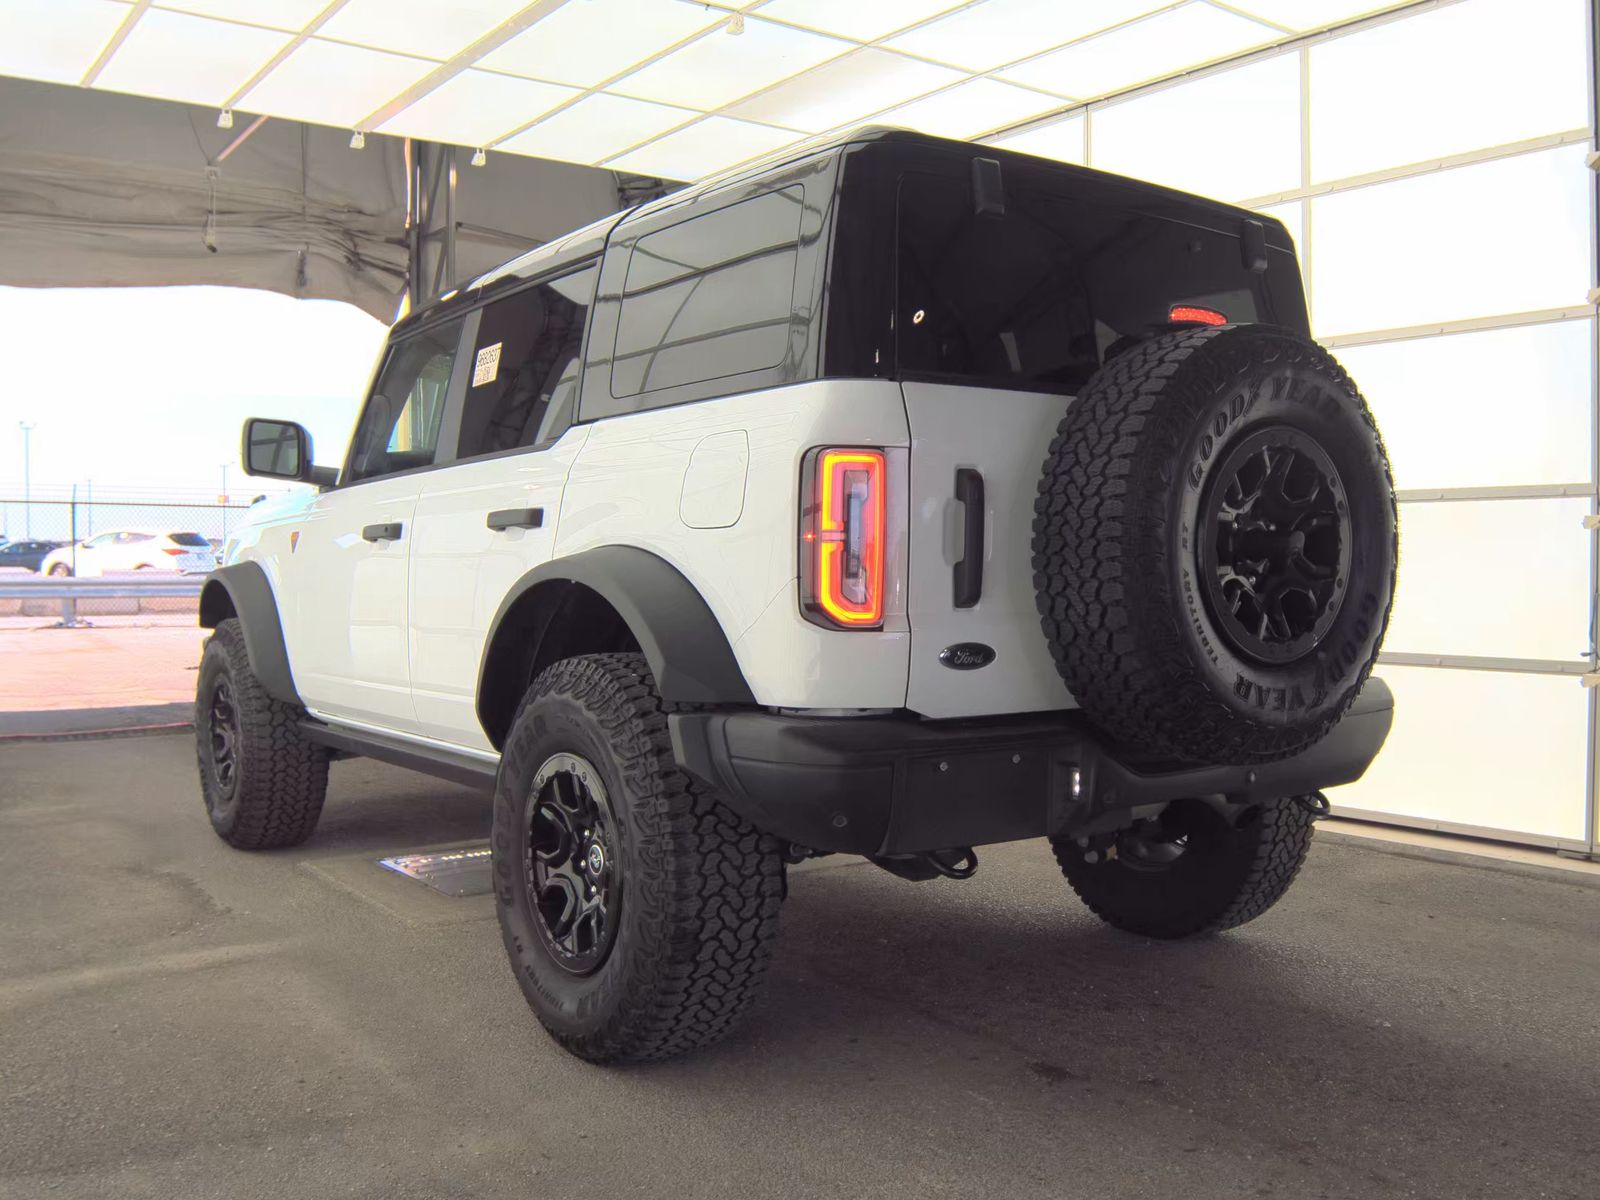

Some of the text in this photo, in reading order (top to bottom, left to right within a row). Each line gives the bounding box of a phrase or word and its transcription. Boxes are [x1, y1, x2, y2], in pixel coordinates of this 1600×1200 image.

[1190, 374, 1340, 489] GOODYEAR
[954, 650, 984, 665] Ford
[1182, 568, 1219, 666] TERRITORY
